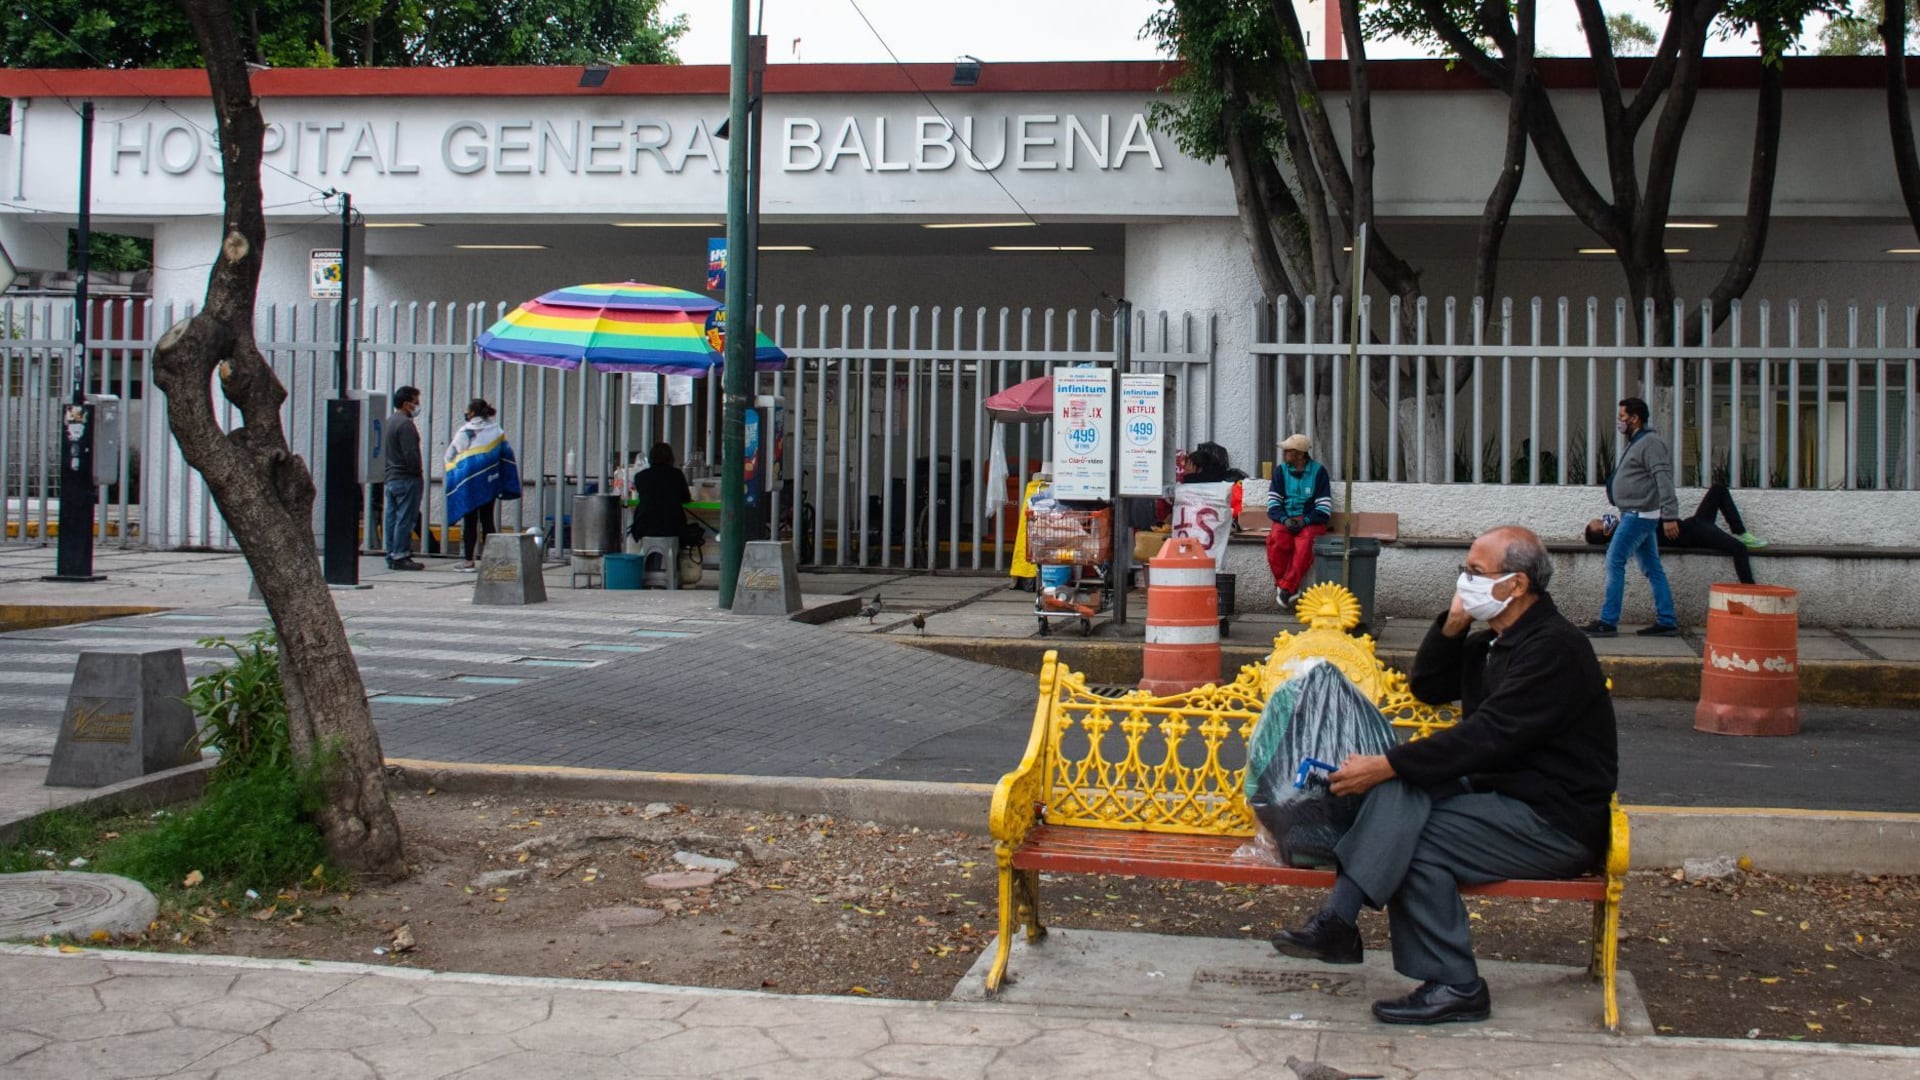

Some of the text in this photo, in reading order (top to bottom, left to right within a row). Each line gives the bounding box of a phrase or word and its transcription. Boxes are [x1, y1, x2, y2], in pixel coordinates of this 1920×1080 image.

[440, 119, 751, 174] GENERA
[782, 113, 1163, 171] BALBUENA
[1057, 384, 1106, 393] infinitum
[1123, 388, 1159, 396] infinitum
[1126, 405, 1156, 415] NETFLIX
[1128, 422, 1153, 436] $499
